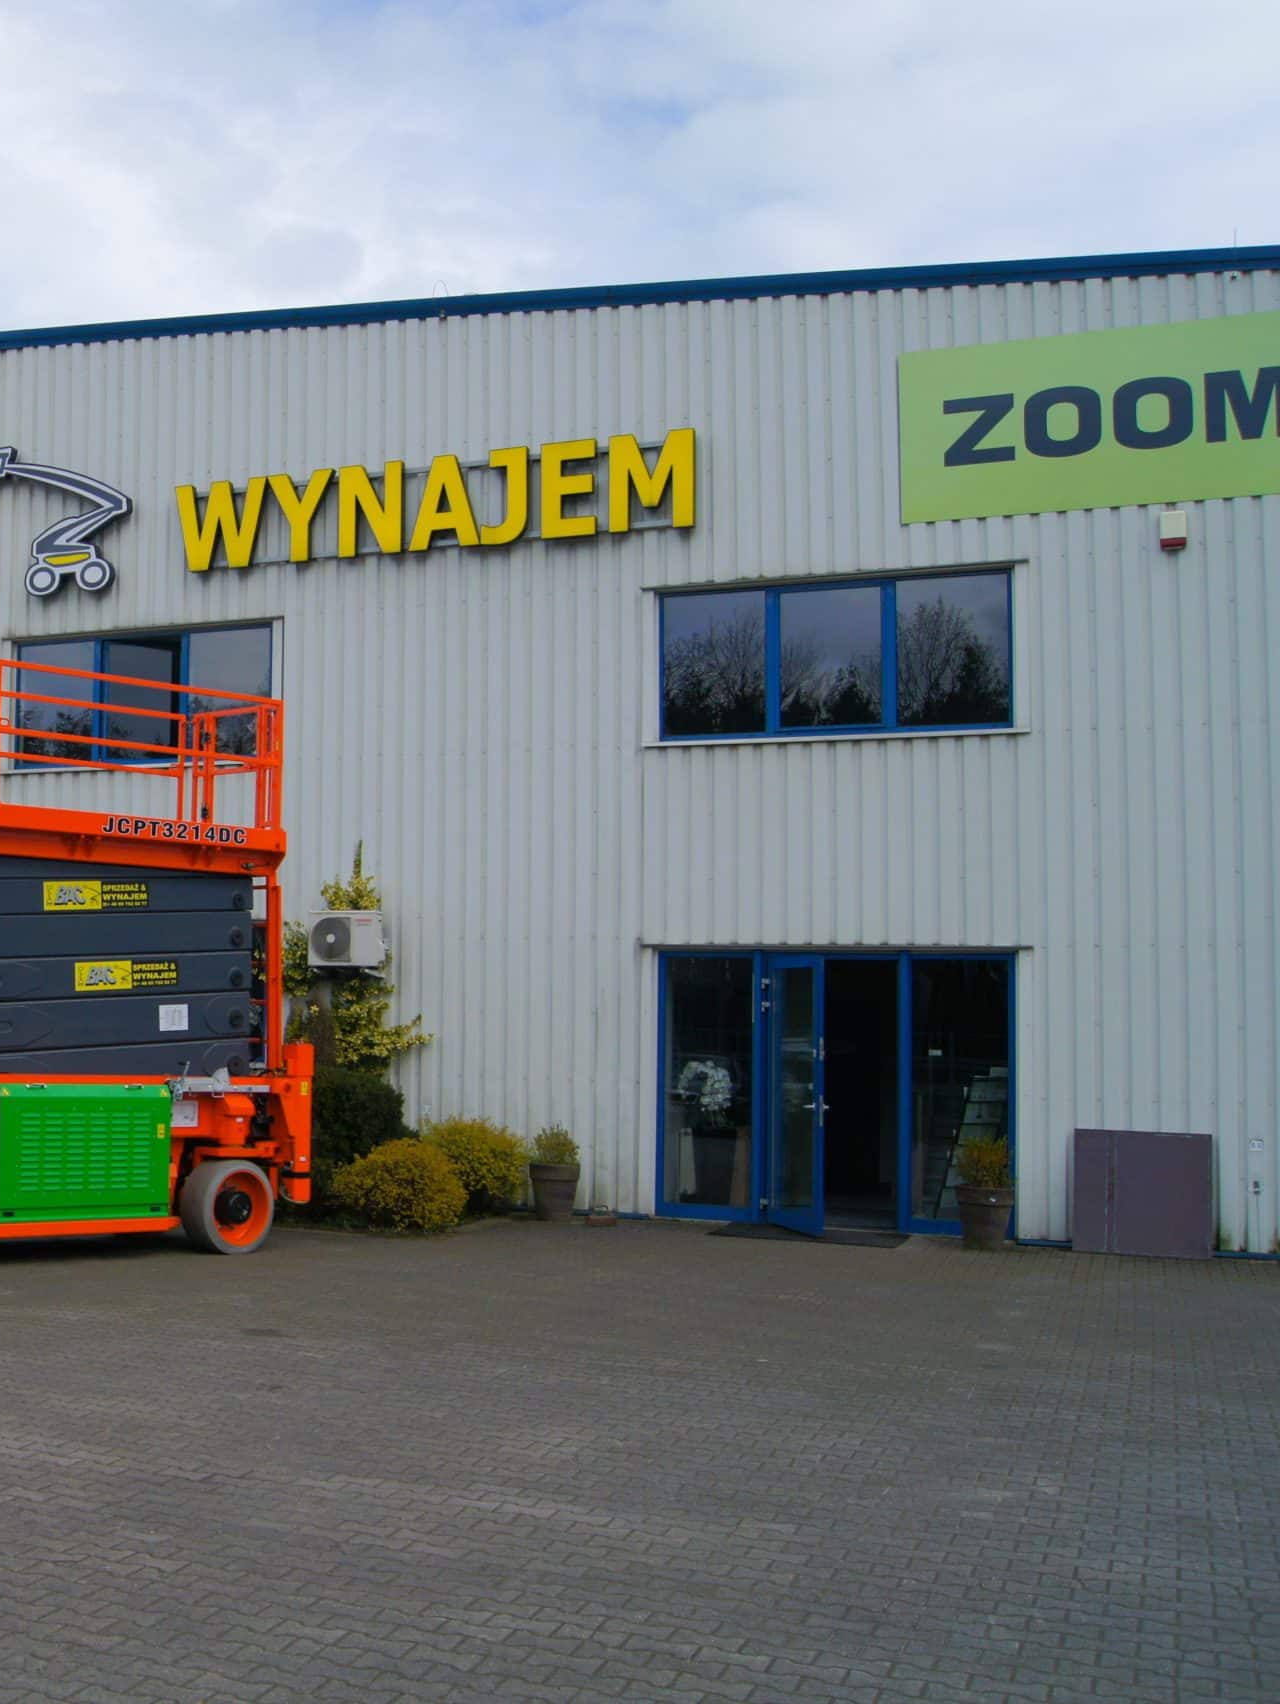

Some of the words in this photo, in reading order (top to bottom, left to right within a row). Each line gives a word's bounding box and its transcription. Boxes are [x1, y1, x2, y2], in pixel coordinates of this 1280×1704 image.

[943, 366, 1280, 467] ZOOM
[175, 427, 696, 573] WYNAJEM
[102, 816, 247, 844] JCPT3214DC
[54, 886, 87, 906] BAC
[103, 892, 147, 900] WYNAJEM
[85, 966, 117, 986] BAC
[133, 971, 177, 980] WYNAJEM
